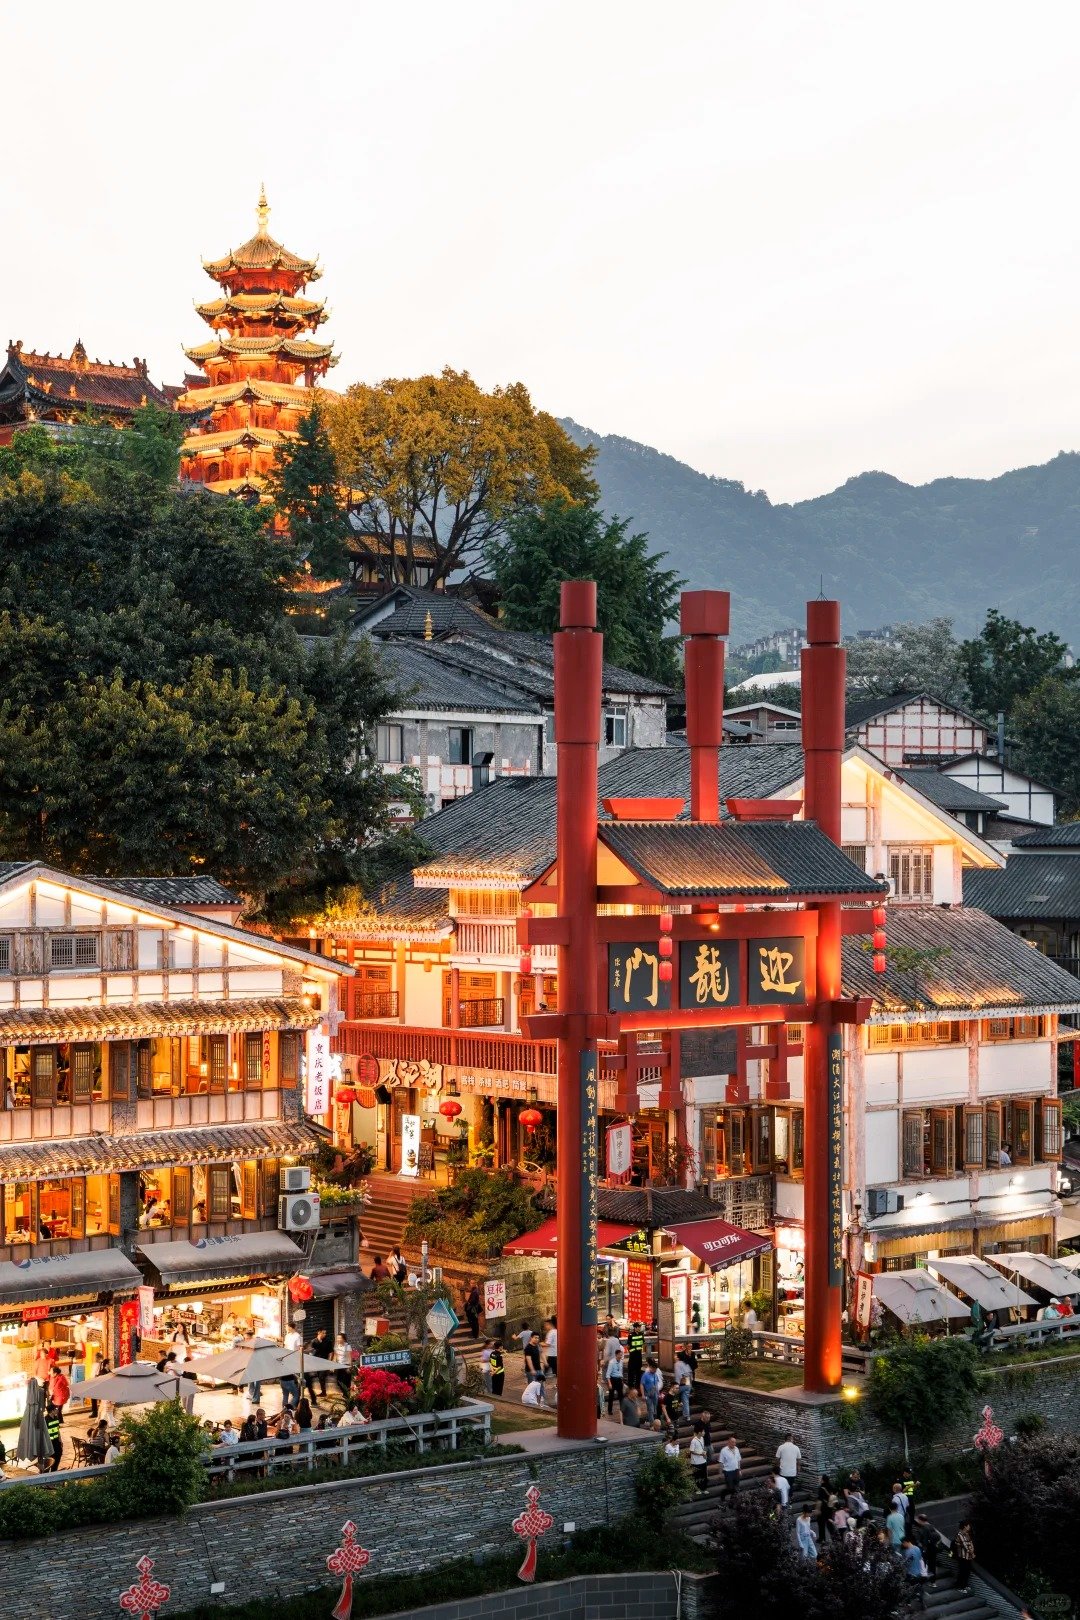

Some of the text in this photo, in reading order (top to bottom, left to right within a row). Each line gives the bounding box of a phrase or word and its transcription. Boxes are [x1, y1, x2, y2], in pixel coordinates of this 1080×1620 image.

[702, 1233, 741, 1251] 可口可乐
[486, 1283, 504, 1296] 豆花
[487, 1296, 505, 1312] 8元
